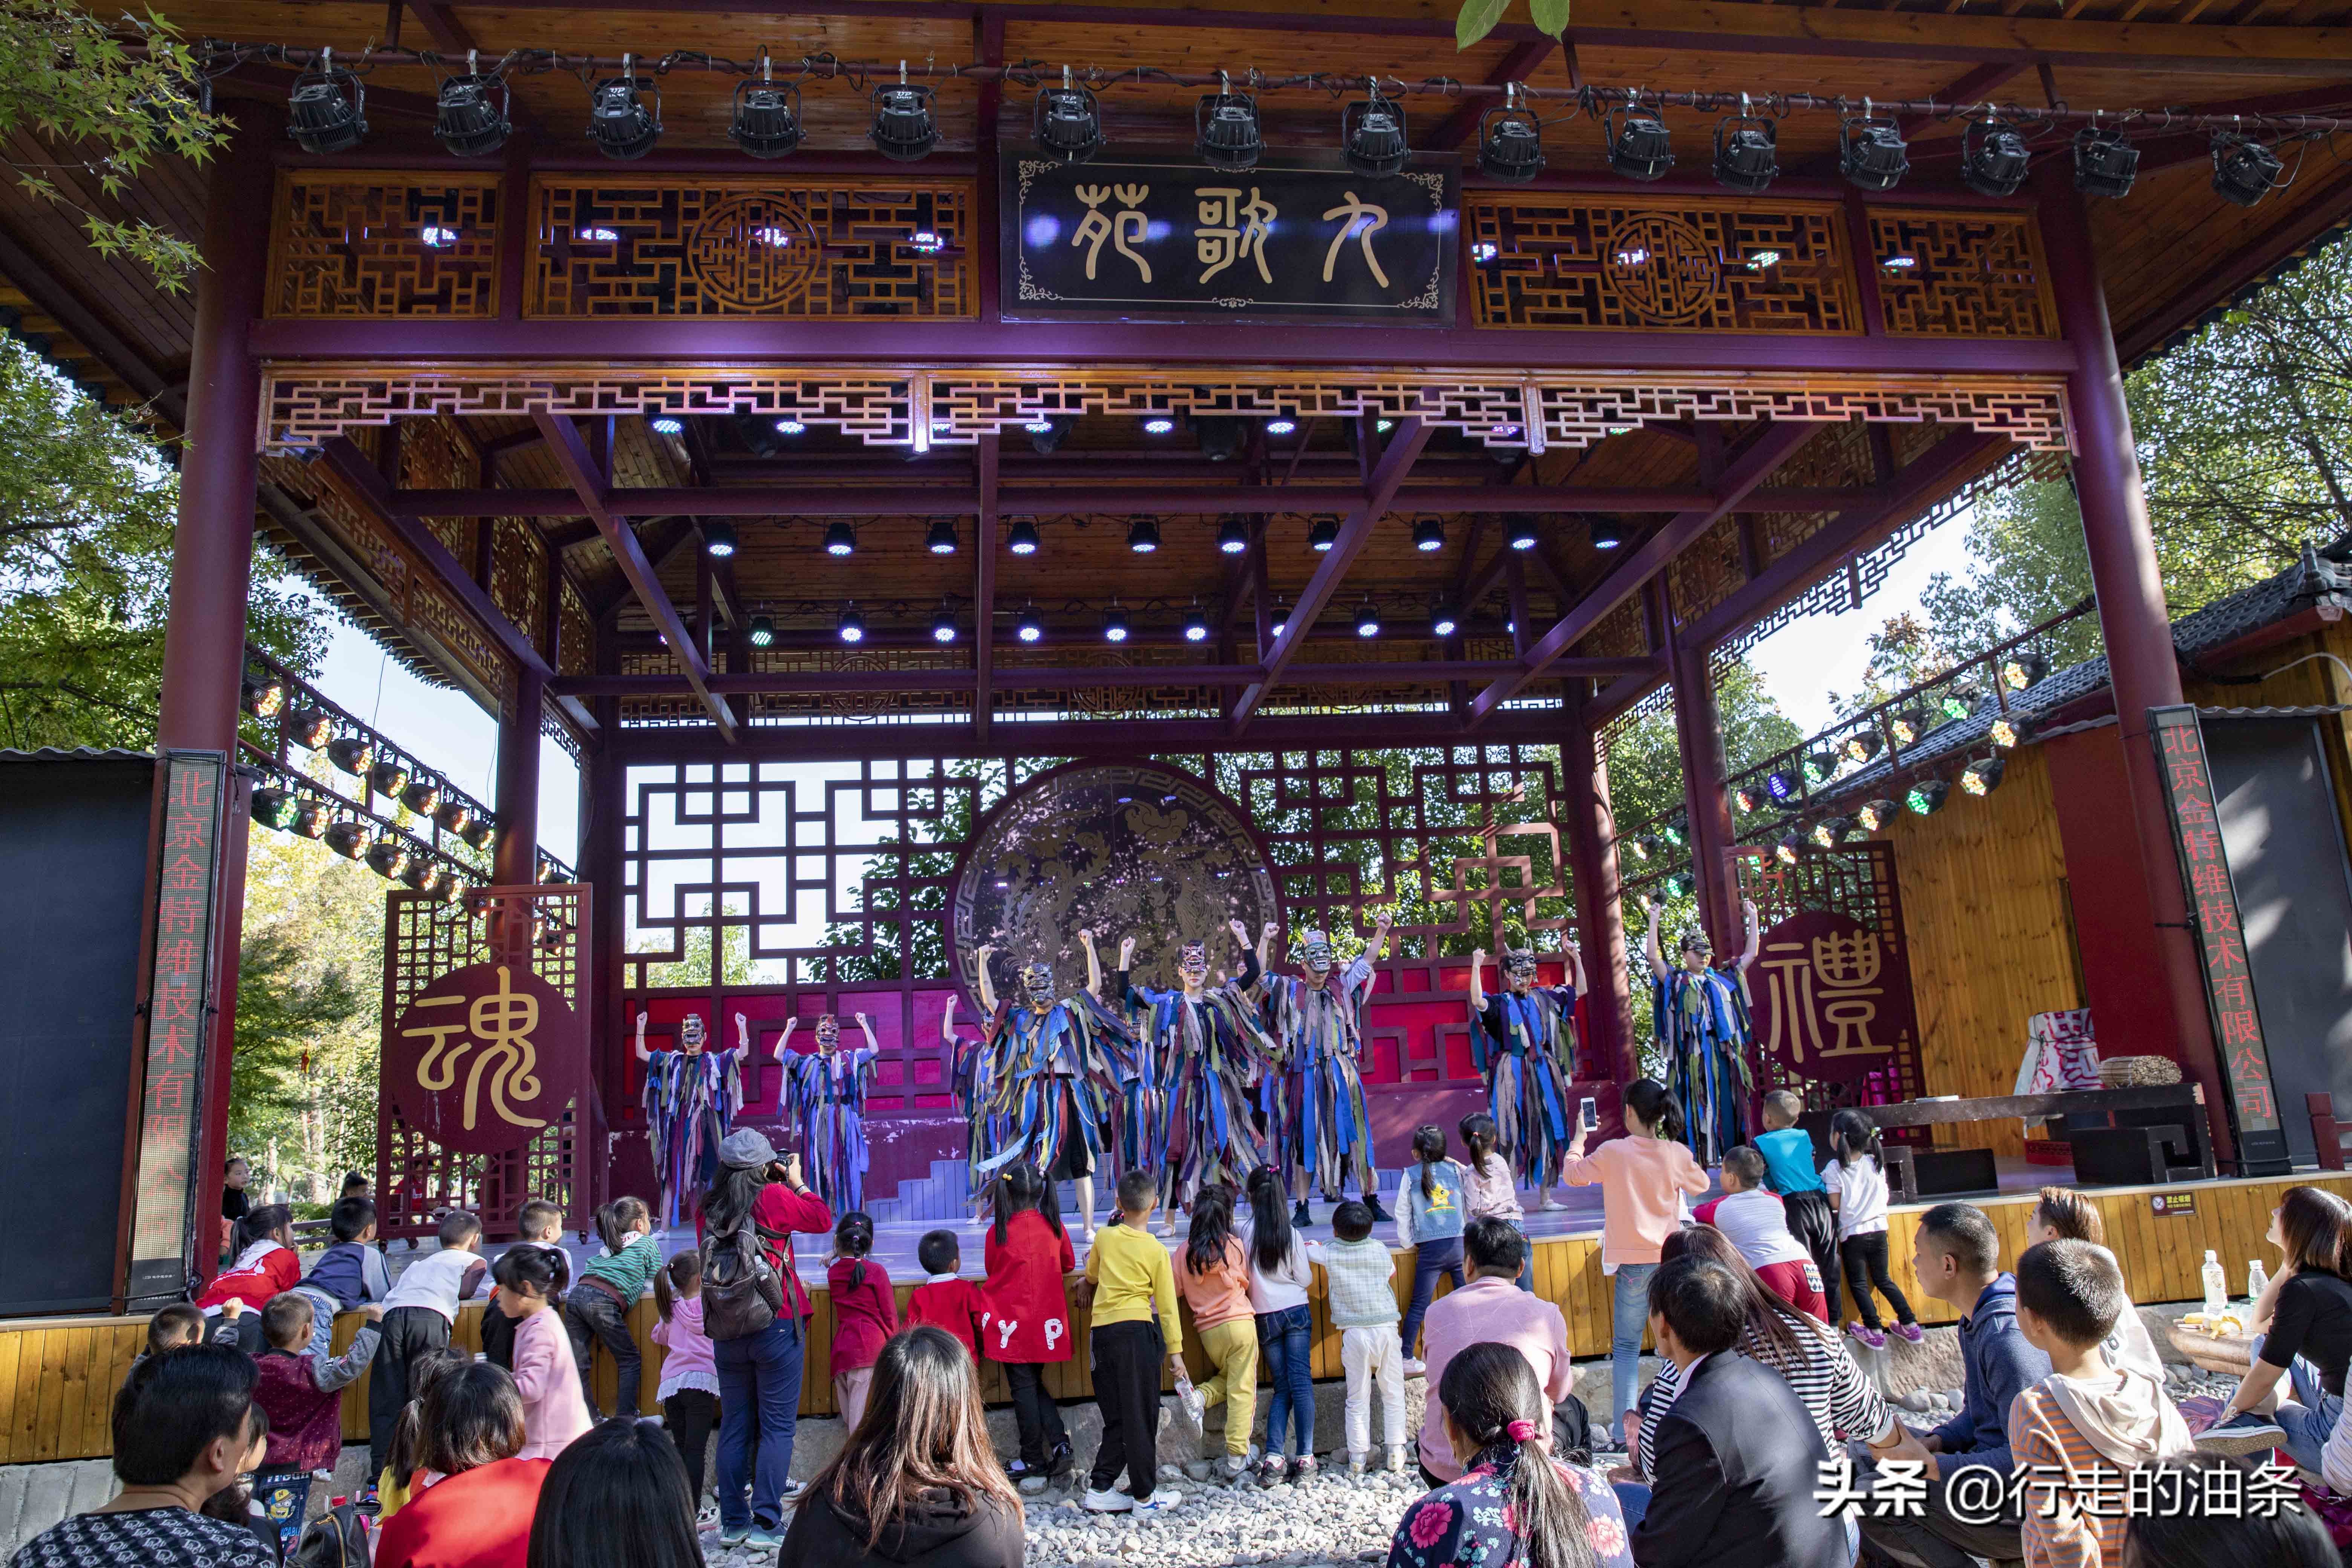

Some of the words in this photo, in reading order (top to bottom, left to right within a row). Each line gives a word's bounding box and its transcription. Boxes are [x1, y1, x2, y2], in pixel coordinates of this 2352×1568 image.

[138, 772, 211, 1243] 北京金特维技术有限公司
[2165, 724, 2271, 1119] 北京金特维技术有限公司
